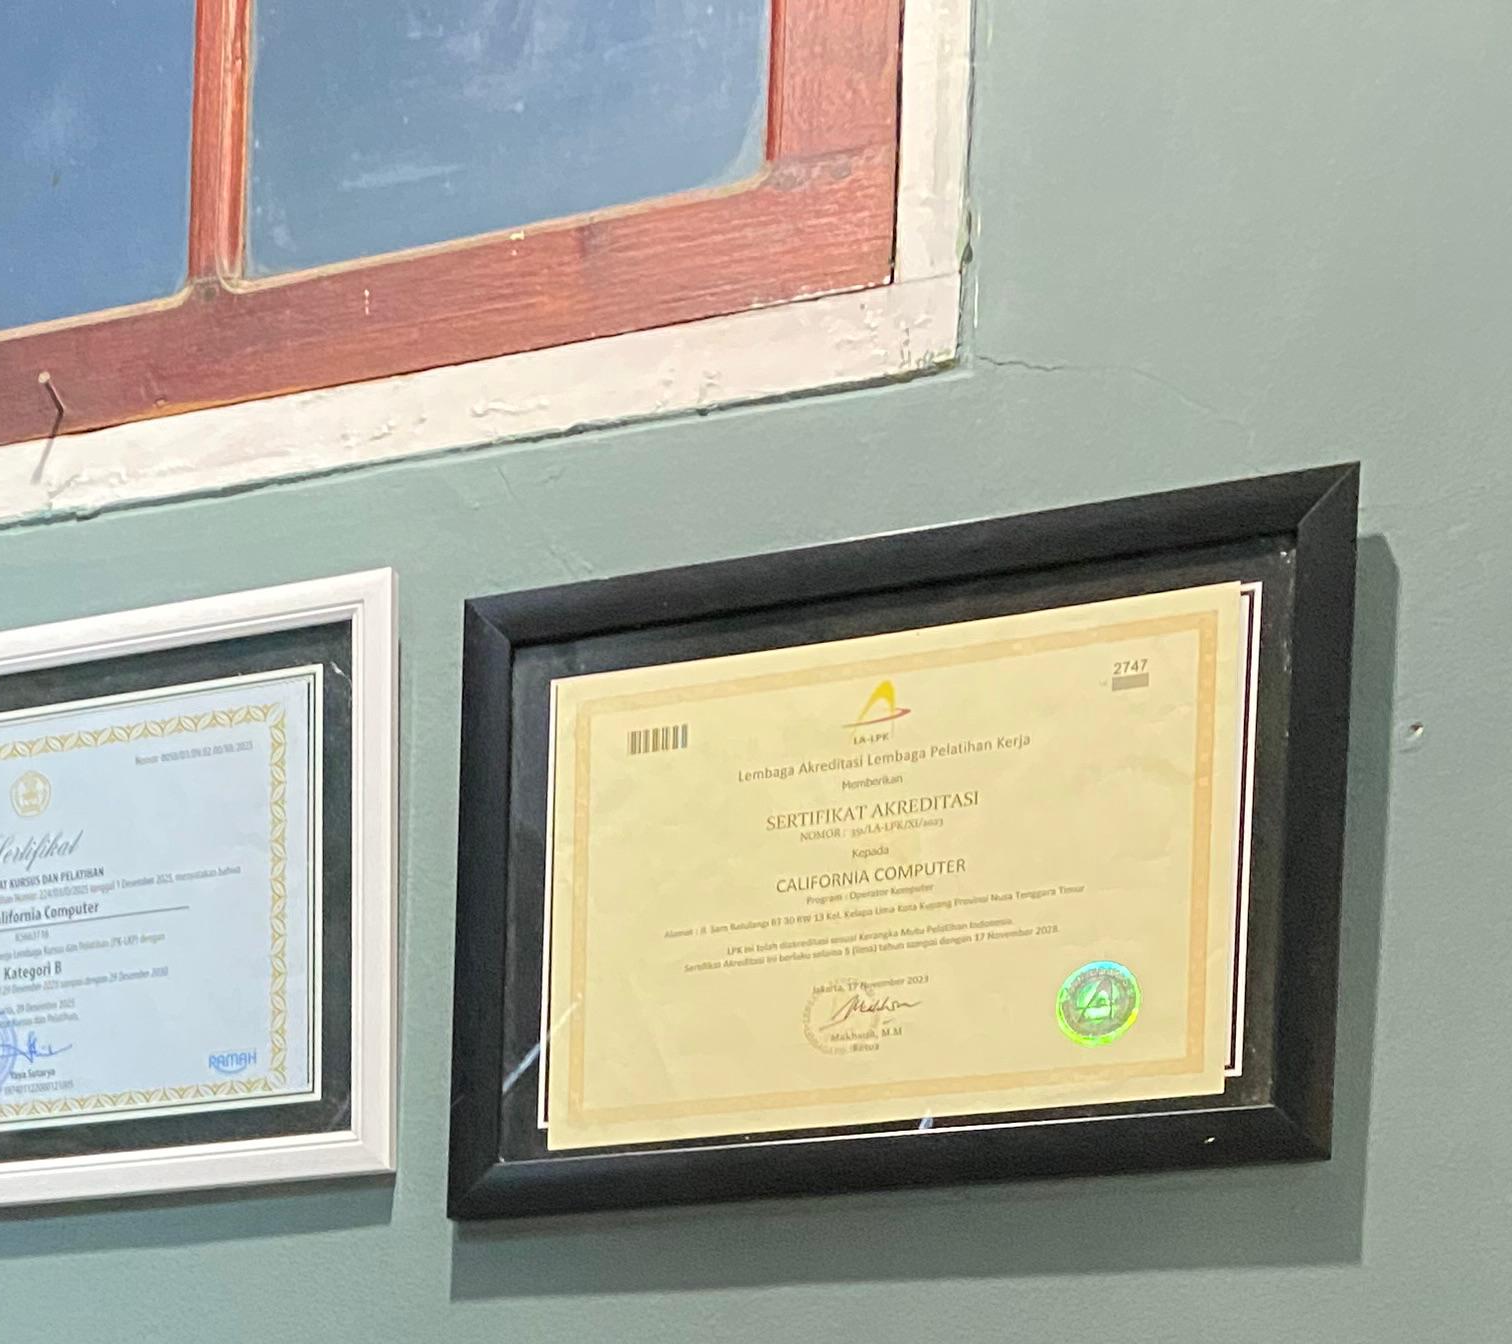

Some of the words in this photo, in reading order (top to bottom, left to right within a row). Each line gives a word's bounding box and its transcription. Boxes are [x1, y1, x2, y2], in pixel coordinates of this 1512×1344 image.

[1113, 658, 1148, 675] 2747
[853, 732, 889, 745] LA-LPK
[738, 765, 795, 783] Lembaga
[798, 755, 864, 775] Akreditasi
[867, 749, 926, 768] Lembaga
[930, 739, 992, 758] Pelatihan
[996, 734, 1031, 752] Kerja
[841, 774, 903, 791] Memberikan
[765, 803, 868, 831] SERTIFIKAT
[870, 790, 979, 819] AKREDITASI
[852, 845, 889, 860] Kepada
[42, 872, 59, 884] DAN
[60, 866, 104, 882] PELATIHAN
[776, 868, 870, 894] CALIFORNIA
[874, 858, 966, 883] COMPUTER
[44, 901, 100, 920] Computer
[4, 962, 52, 982] Kategori
[54, 960, 63, 975] B
